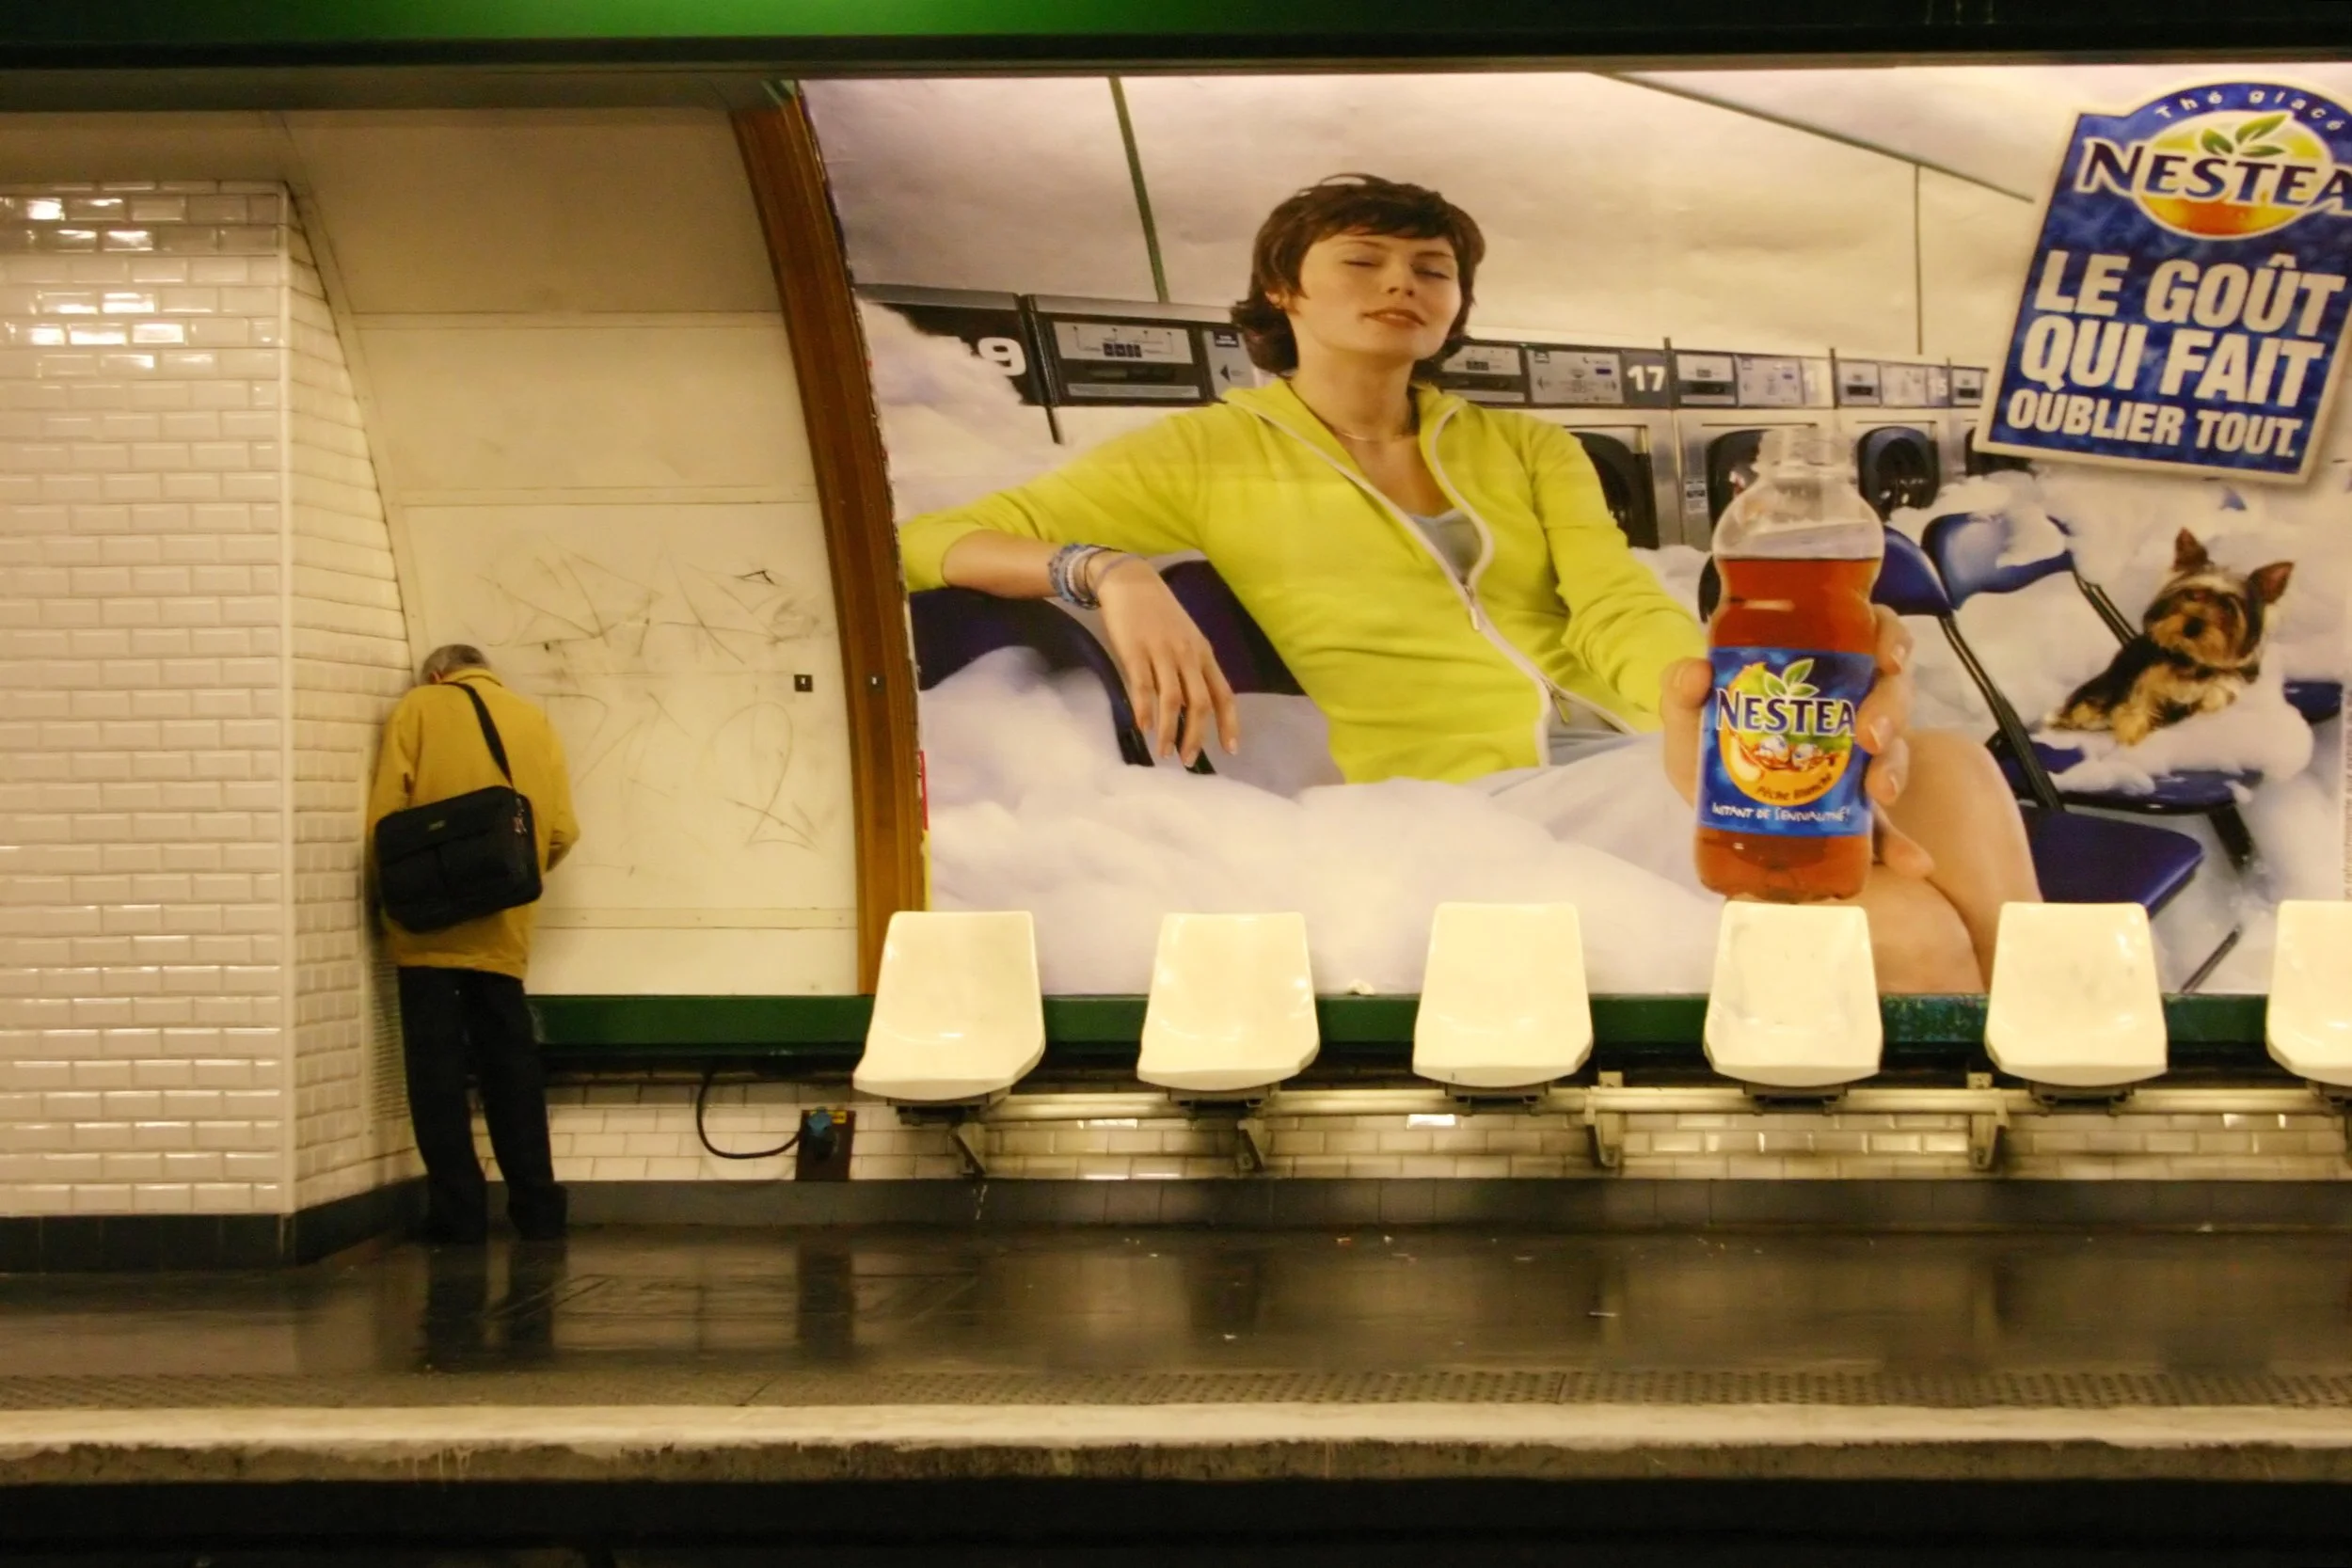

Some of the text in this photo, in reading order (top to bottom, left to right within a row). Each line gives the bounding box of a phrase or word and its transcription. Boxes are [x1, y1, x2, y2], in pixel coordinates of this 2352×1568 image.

[2077, 139, 2352, 217] NESTEA
[2033, 249, 2345, 337] LE GOÛT
[1628, 365, 1665, 391] 17
[2020, 315, 2325, 407] QUI FAIT
[2007, 388, 2302, 458] OUBLIER TOUT.
[1716, 688, 1855, 736] NESTEA
